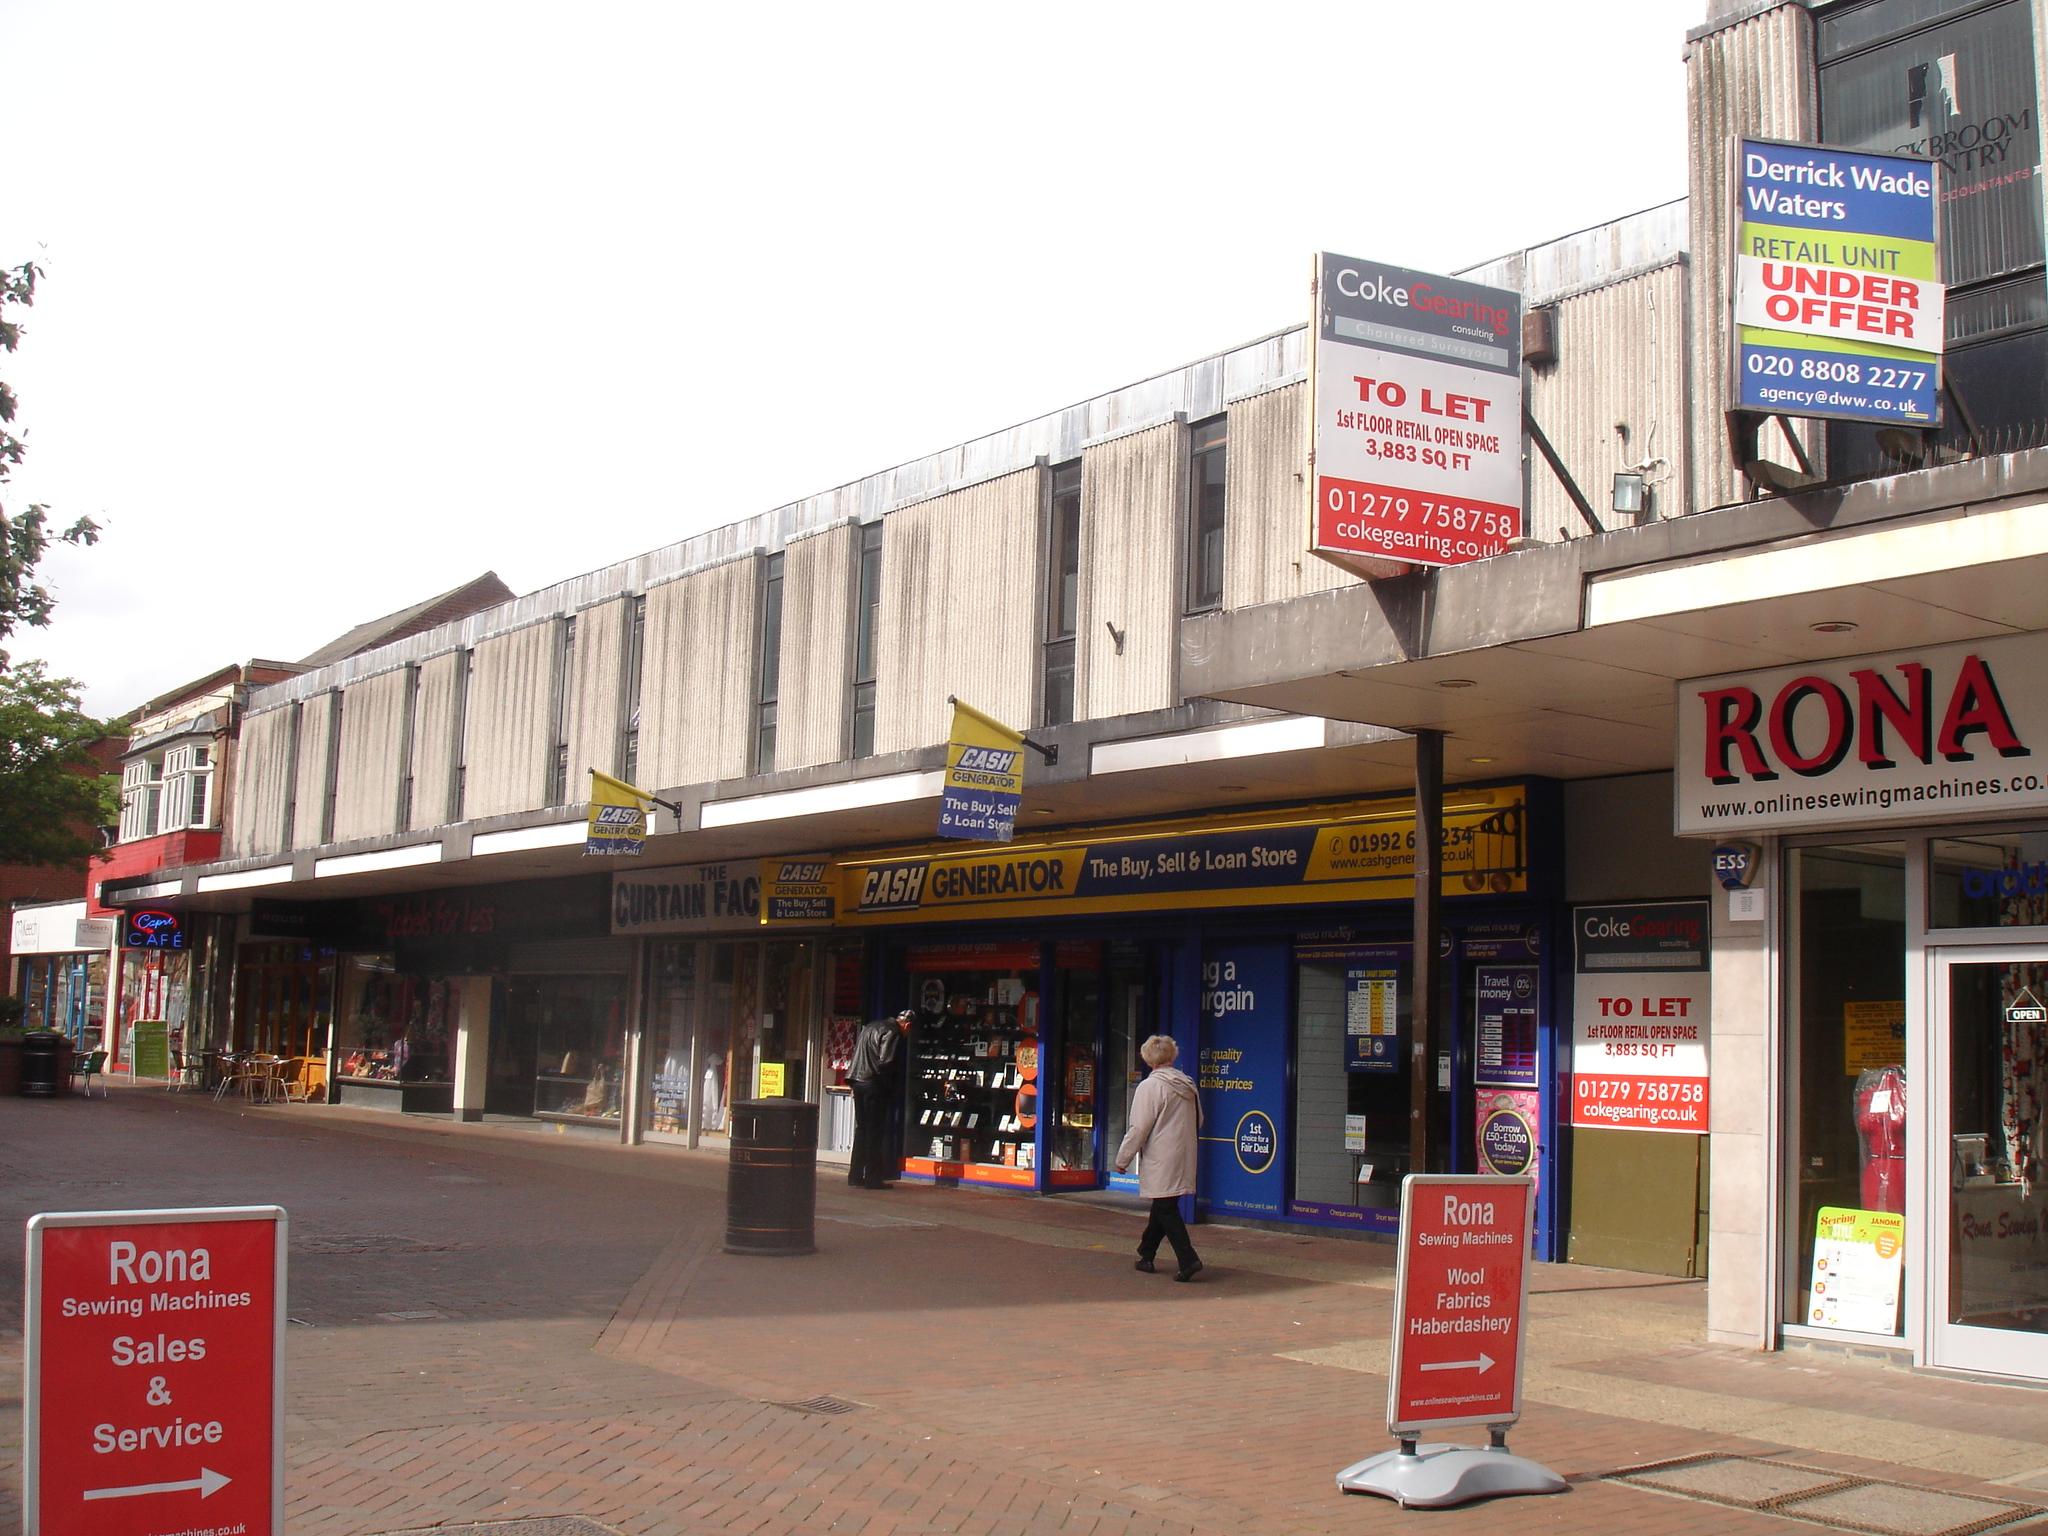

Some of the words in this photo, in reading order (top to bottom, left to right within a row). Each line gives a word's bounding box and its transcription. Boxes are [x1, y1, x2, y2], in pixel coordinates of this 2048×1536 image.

[1895, 109, 2029, 157] KBROOM
[1746, 154, 1845, 189] Derrick
[1855, 167, 1930, 198] Wade
[1747, 186, 1845, 220] Waters
[1753, 237, 1834, 265] RETAIL
[1843, 246, 1900, 271] UNIT
[1762, 265, 1919, 309] UNDER
[1766, 295, 1914, 339] OFFER
[1356, 323, 1424, 347] Chartered
[1432, 338, 1494, 360] Surveyors
[1452, 324, 1494, 341] consulting
[1748, 353, 1793, 376] 020
[1801, 360, 1860, 384] 8808
[1867, 366, 1925, 391] 2277
[1353, 376, 1406, 407] TO
[1421, 389, 1491, 423] LET
[1759, 386, 1916, 413] agency@dww.co.uk
[1337, 409, 1354, 429] 1st
[1357, 413, 1393, 436] FLOOR
[1396, 420, 1432, 443] RETAIL
[1434, 428, 1463, 448] OPEN
[1466, 434, 1499, 454] SPACE
[1366, 438, 1417, 462] 3,883
[1422, 449, 1447, 471] SQ
[1452, 455, 1471, 471] FT
[1329, 488, 1409, 521] 01279
[1421, 502, 1512, 538] 758758
[1337, 520, 1504, 562] cokegearing.co.uk
[1698, 655, 2031, 786] RONA
[960, 749, 1014, 771] CASH
[952, 772, 1015, 788] GENERATOR
[1701, 775, 2048, 818] www.onlinesewingmachines.co.
[599, 807, 641, 823] CASH
[945, 797, 968, 811] The
[971, 801, 996, 816] Buy,
[997, 803, 1017, 816] Sell
[942, 813, 952, 824] &
[955, 815, 984, 828] Loan
[1350, 832, 1400, 853] 01992
[1406, 827, 1472, 850] 6234
[589, 846, 605, 856] The
[1330, 848, 1473, 869] www.cashgenerco.uk
[1090, 856, 1119, 879] The
[1121, 856, 1153, 880] Buy,
[1157, 852, 1185, 873] Sell
[1189, 850, 1201, 870] &
[1205, 849, 1247, 871] Loan
[1251, 846, 1297, 868] Store
[1716, 855, 1746, 870] ESS
[700, 866, 726, 881] THE
[779, 865, 825, 881] CASH
[861, 866, 925, 905] CASH
[932, 858, 1064, 898] GENERATOR
[775, 886, 827, 895] GENERATOR
[615, 882, 706, 928] CURTAIN
[713, 877, 761, 918] FAC
[777, 900, 791, 908] The
[813, 899, 826, 907] Sell
[138, 914, 174, 929] Capri
[777, 909, 783, 917] &
[785, 909, 804, 917] Loan
[806, 909, 827, 917] Store
[129, 931, 184, 947] CAFÉ
[1224, 961, 1236, 980] a
[1483, 976, 1510, 987] Travel
[1516, 979, 1530, 990] 0%
[1480, 989, 1512, 1000] money
[1599, 998, 1632, 1017] TO
[1642, 998, 1692, 1017] LET
[2013, 1010, 2040, 1020] OPEN
[1587, 1026, 1598, 1038] 1st
[1600, 1026, 1623, 1039] FLOOR
[1625, 1026, 1648, 1039] RETAIL
[1650, 1026, 1671, 1039] OPEN
[1673, 1026, 1697, 1040] SPACE
[1212, 1048, 1242, 1063] quality
[1605, 1043, 1637, 1058] 3,883
[1641, 1044, 1657, 1057] SQ
[1661, 1044, 1676, 1057] FT
[1220, 1064, 1229, 1075] at
[1225, 1078, 1253, 1092] prices
[1579, 1080, 1630, 1100] 01279
[1637, 1083, 1703, 1102] 758758
[1584, 1102, 1697, 1122] cokegearing.co.uk
[1250, 1123, 1261, 1134] 1st
[1493, 1122, 1521, 1133] Borrow
[1241, 1143, 1252, 1152] Fair
[1253, 1144, 1269, 1153] Deal
[1444, 1195, 1494, 1226] Rona
[1820, 1214, 1856, 1226] Sewing
[1871, 1217, 1900, 1227] JANOME
[1419, 1232, 1459, 1248] Sewing
[1462, 1231, 1513, 1246] Machines
[110, 1241, 211, 1286] Rona
[1448, 1268, 1484, 1286] Wool
[62, 1296, 143, 1318] Sewing
[150, 1290, 251, 1312] Machines
[1437, 1292, 1491, 1311] Fabrics
[1411, 1316, 1512, 1336] Haberdashery
[111, 1333, 206, 1367] Sales
[146, 1375, 172, 1407] &
[93, 1417, 223, 1455] Service
